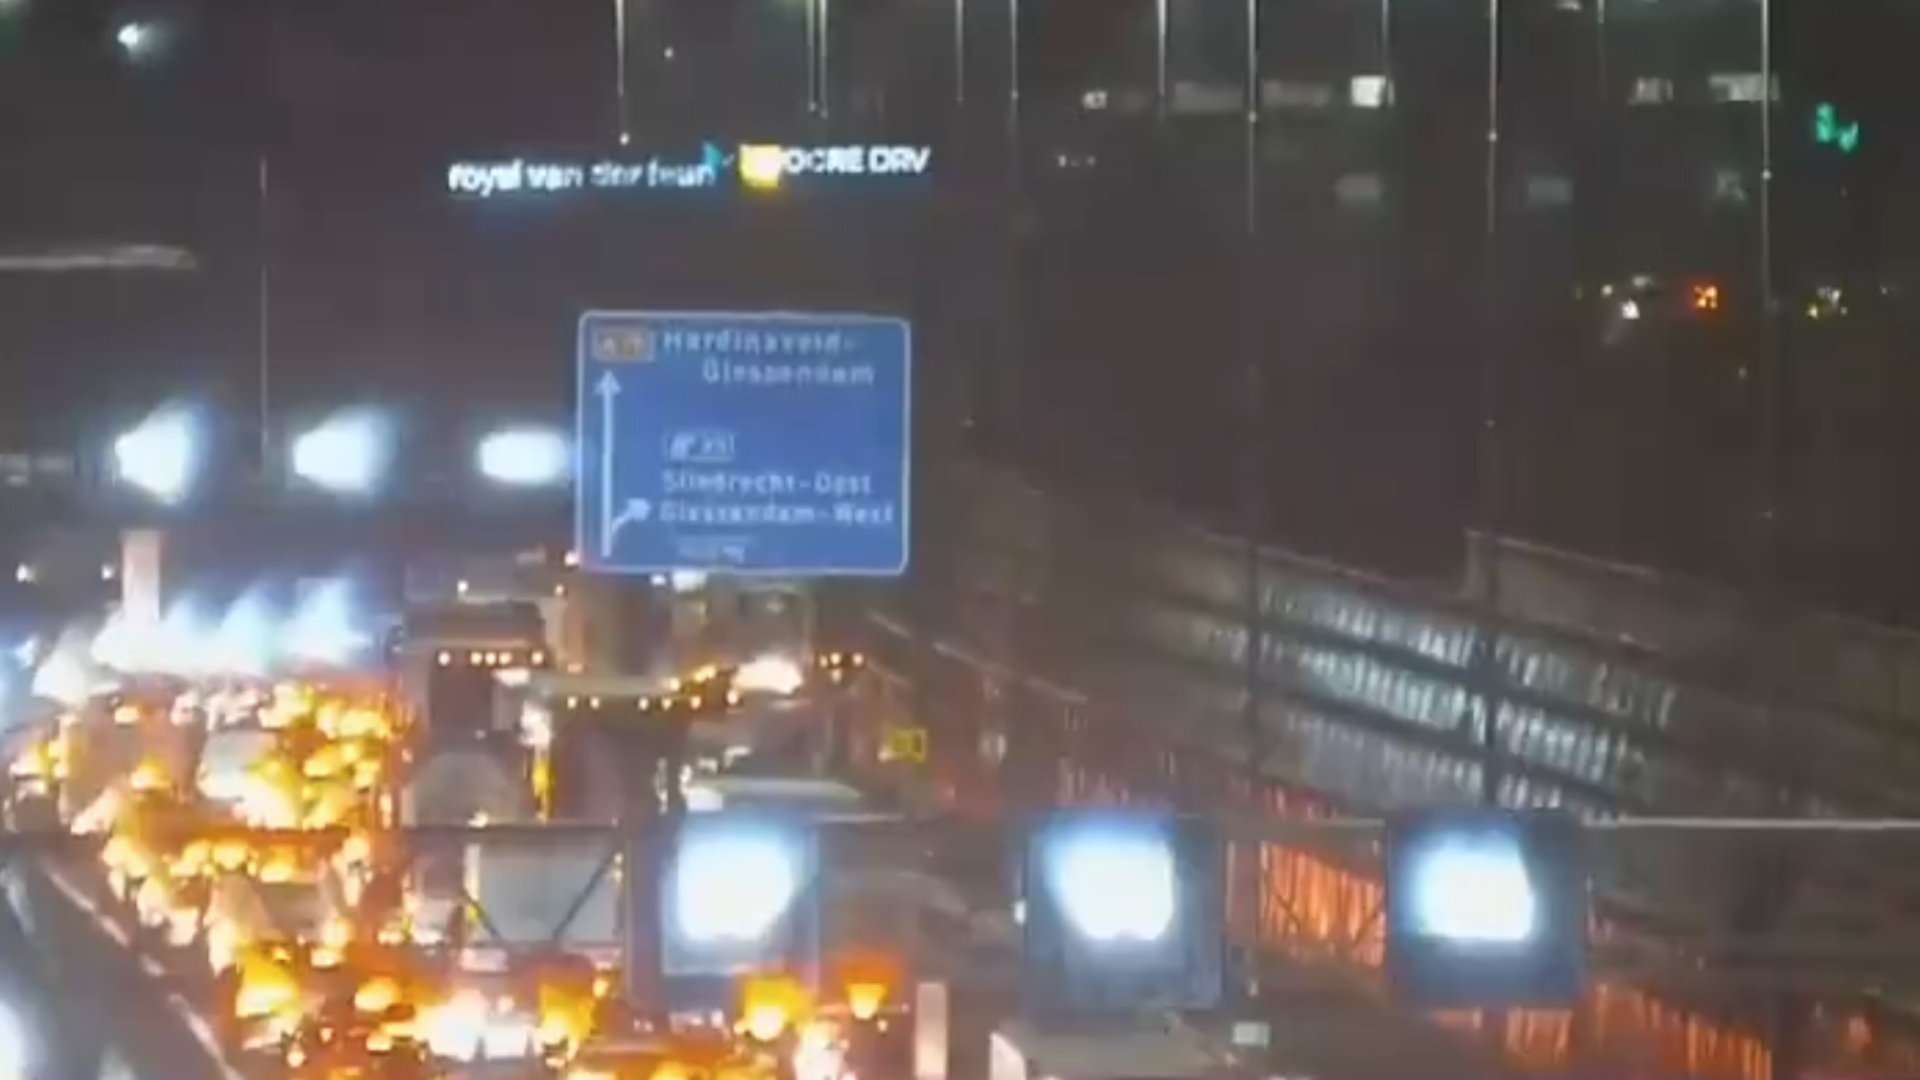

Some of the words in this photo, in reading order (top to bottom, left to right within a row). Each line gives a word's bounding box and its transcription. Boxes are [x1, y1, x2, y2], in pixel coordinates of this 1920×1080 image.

[869, 146, 930, 174] DRV
[448, 159, 522, 197] royal
[527, 163, 585, 191] van
